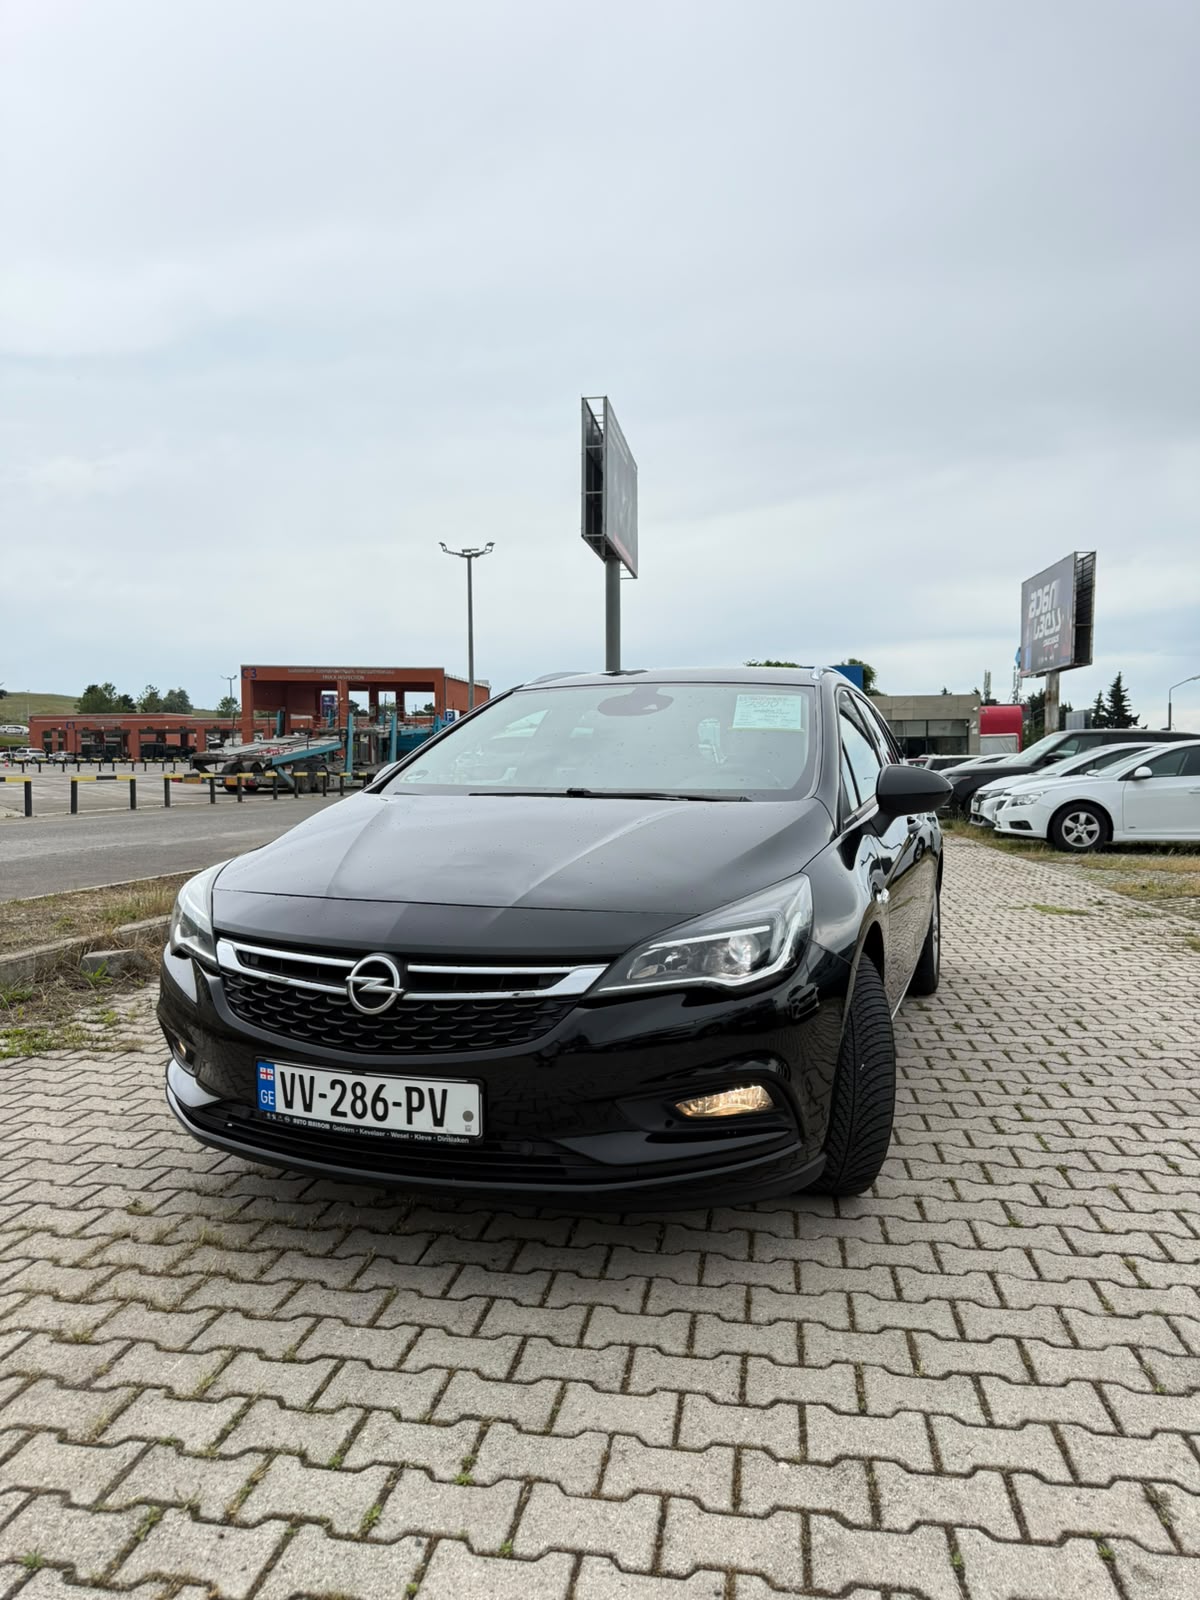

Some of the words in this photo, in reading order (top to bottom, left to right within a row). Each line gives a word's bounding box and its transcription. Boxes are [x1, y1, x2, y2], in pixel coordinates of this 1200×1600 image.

[446, 712, 453, 722] P
[260, 1089, 275, 1106] GE
[279, 1071, 448, 1128] VV-286-PV
[332, 1125, 355, 1133] Geldern
[390, 1131, 410, 1139] Wesel
[414, 1133, 432, 1141] Kleve
